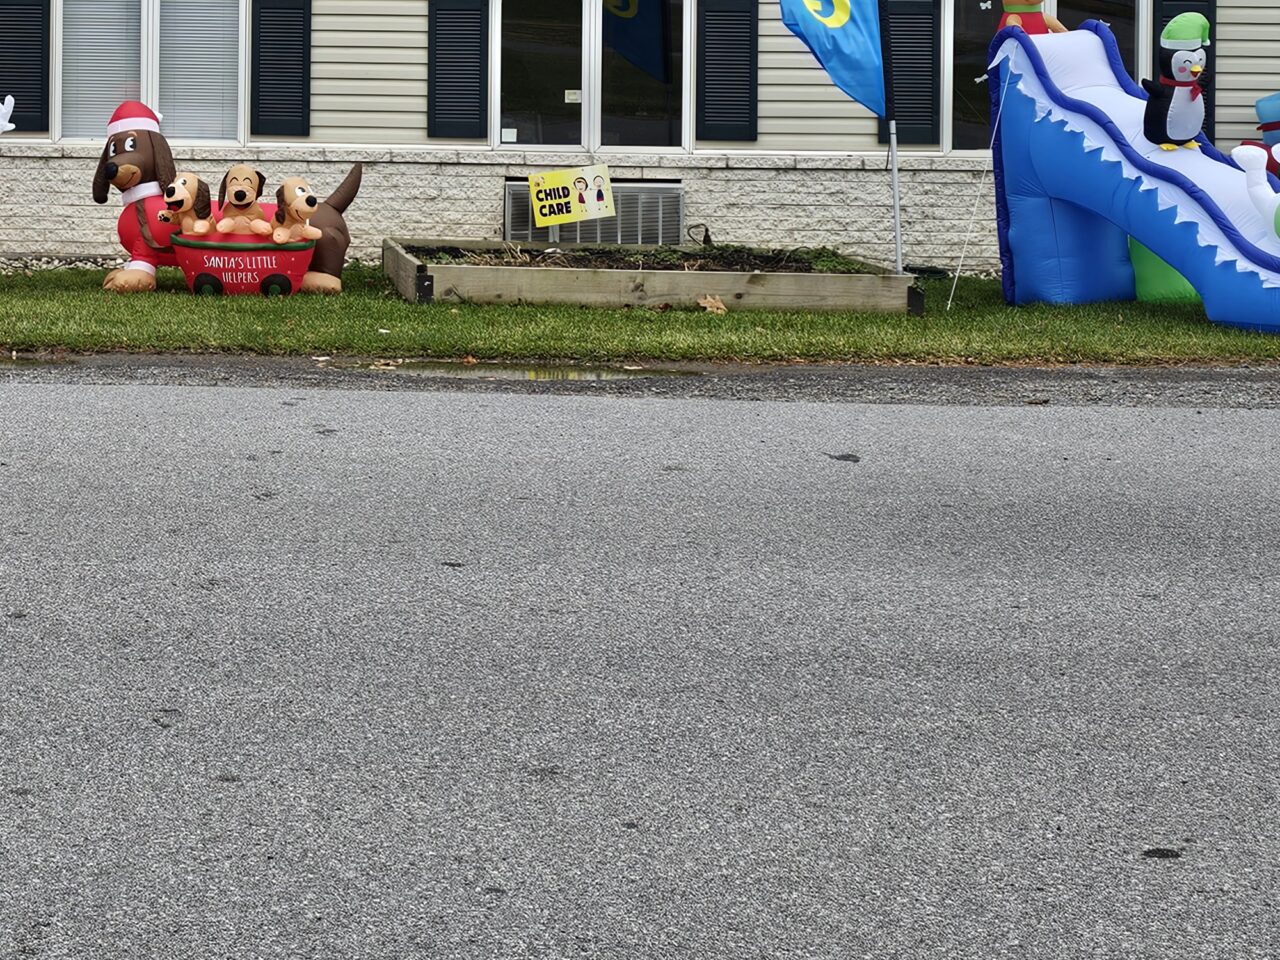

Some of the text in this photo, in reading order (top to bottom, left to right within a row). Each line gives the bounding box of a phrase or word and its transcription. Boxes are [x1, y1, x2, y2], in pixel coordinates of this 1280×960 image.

[536, 186, 570, 202] CHILD
[539, 201, 572, 217] CARE
[246, 256, 277, 269] LITTLE
[222, 272, 259, 283] HELPERS
